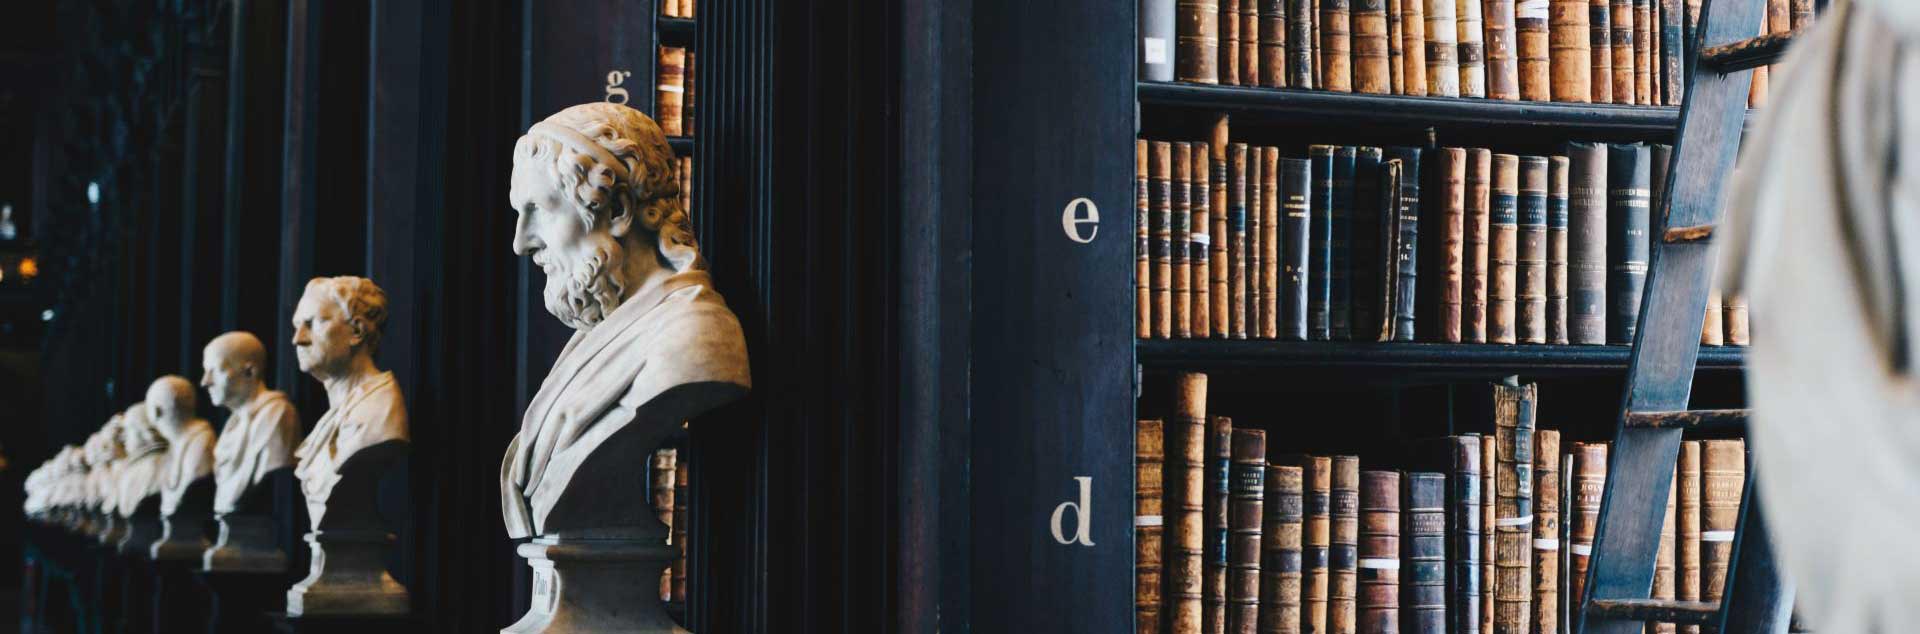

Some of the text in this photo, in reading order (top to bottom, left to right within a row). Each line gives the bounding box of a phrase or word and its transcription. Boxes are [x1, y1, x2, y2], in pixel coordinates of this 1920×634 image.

[606, 70, 631, 104] g
[1062, 197, 1099, 243] e
[1050, 476, 1096, 546] d
